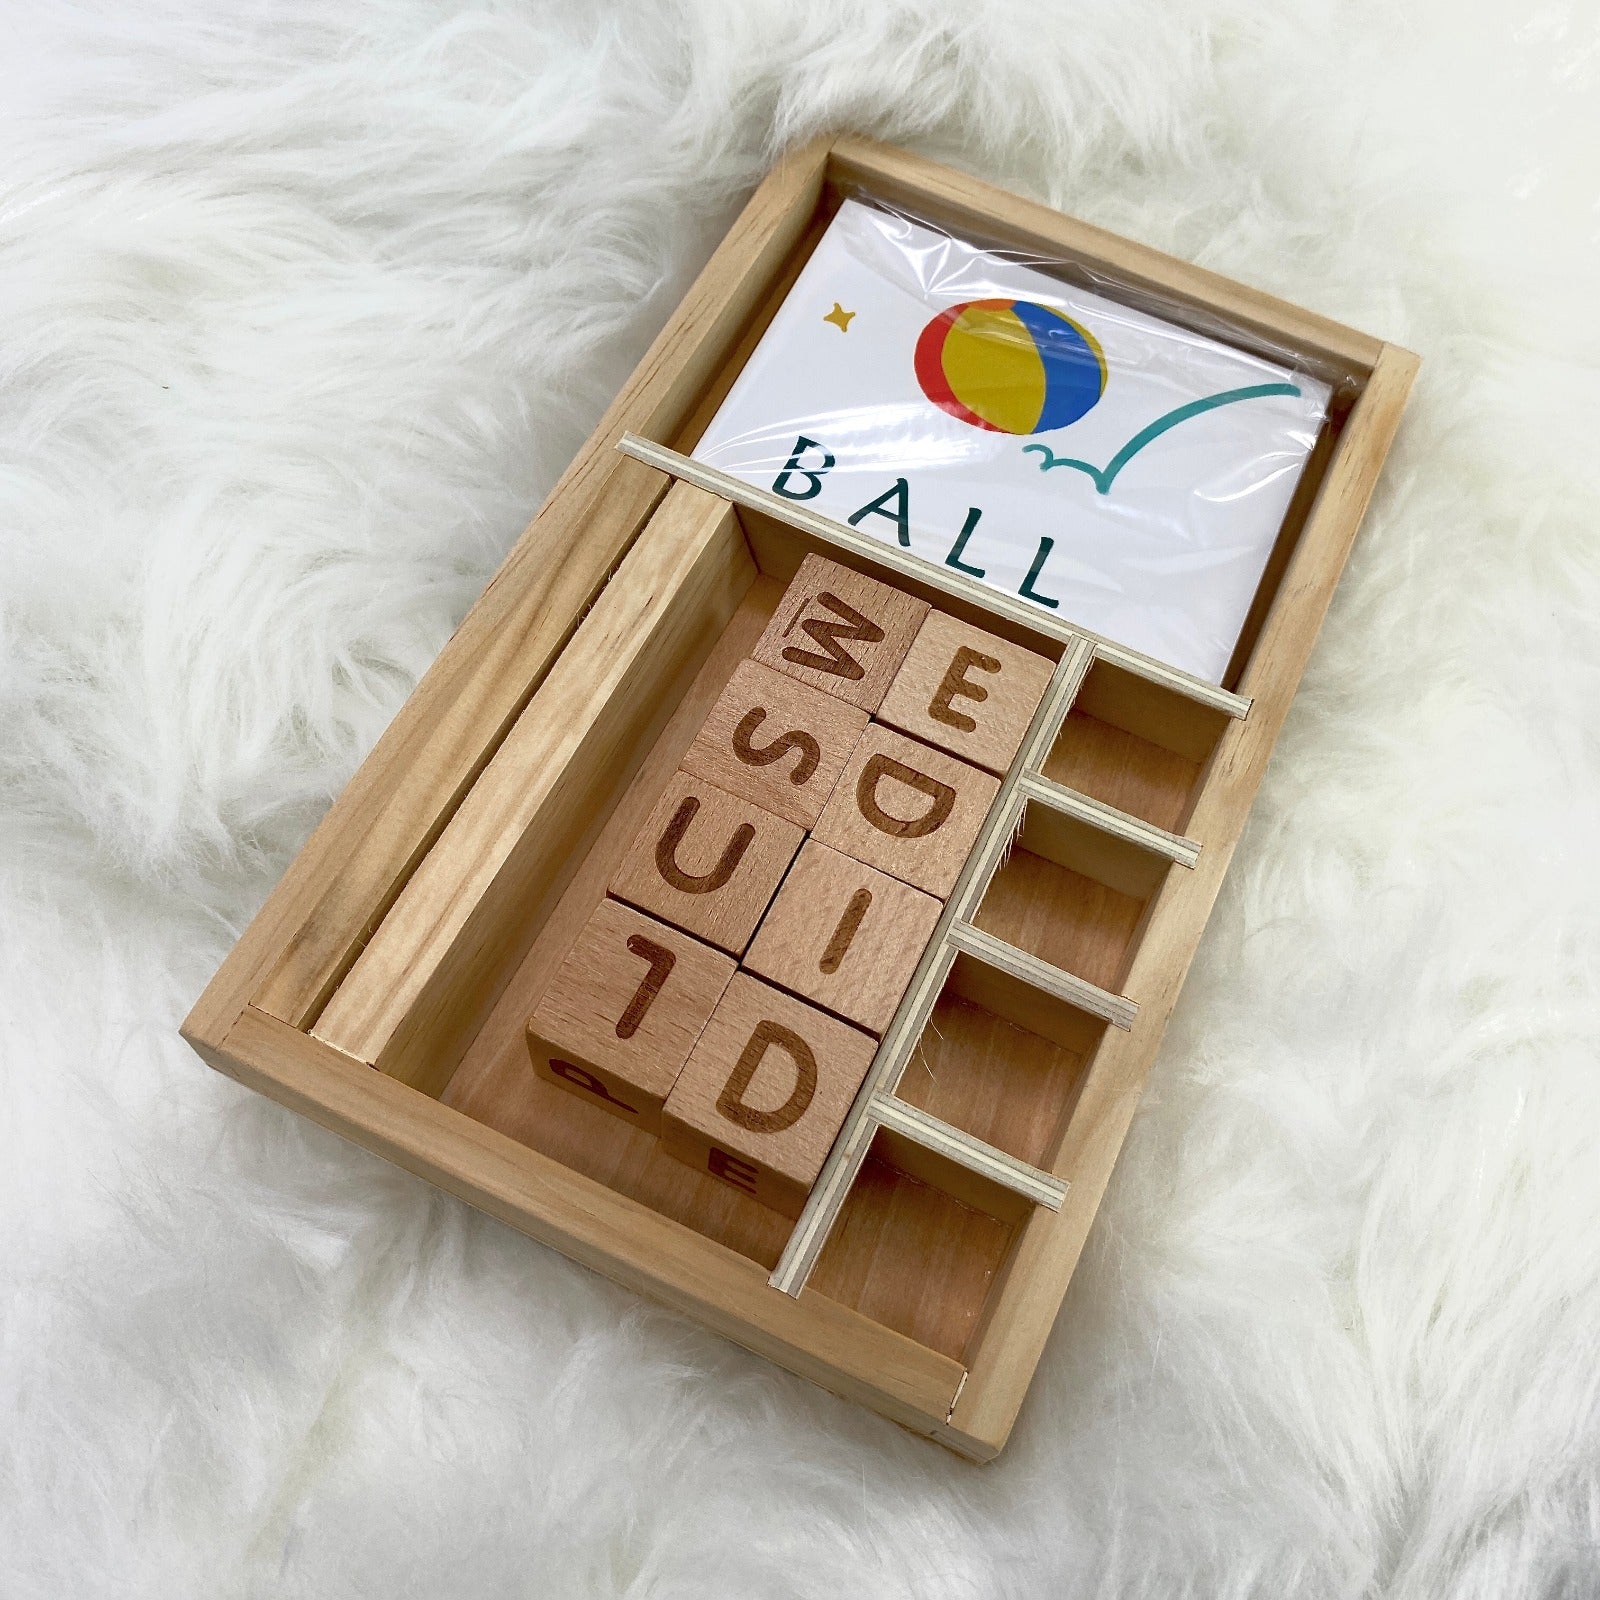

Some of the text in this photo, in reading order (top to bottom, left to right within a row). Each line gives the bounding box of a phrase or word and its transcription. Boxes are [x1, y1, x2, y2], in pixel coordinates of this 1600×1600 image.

[772, 436, 1059, 608] BALL
[928, 645, 1002, 733] E
[732, 706, 821, 785] S
[856, 753, 956, 838] D
[655, 796, 756, 894] U
[716, 1020, 818, 1134] D
